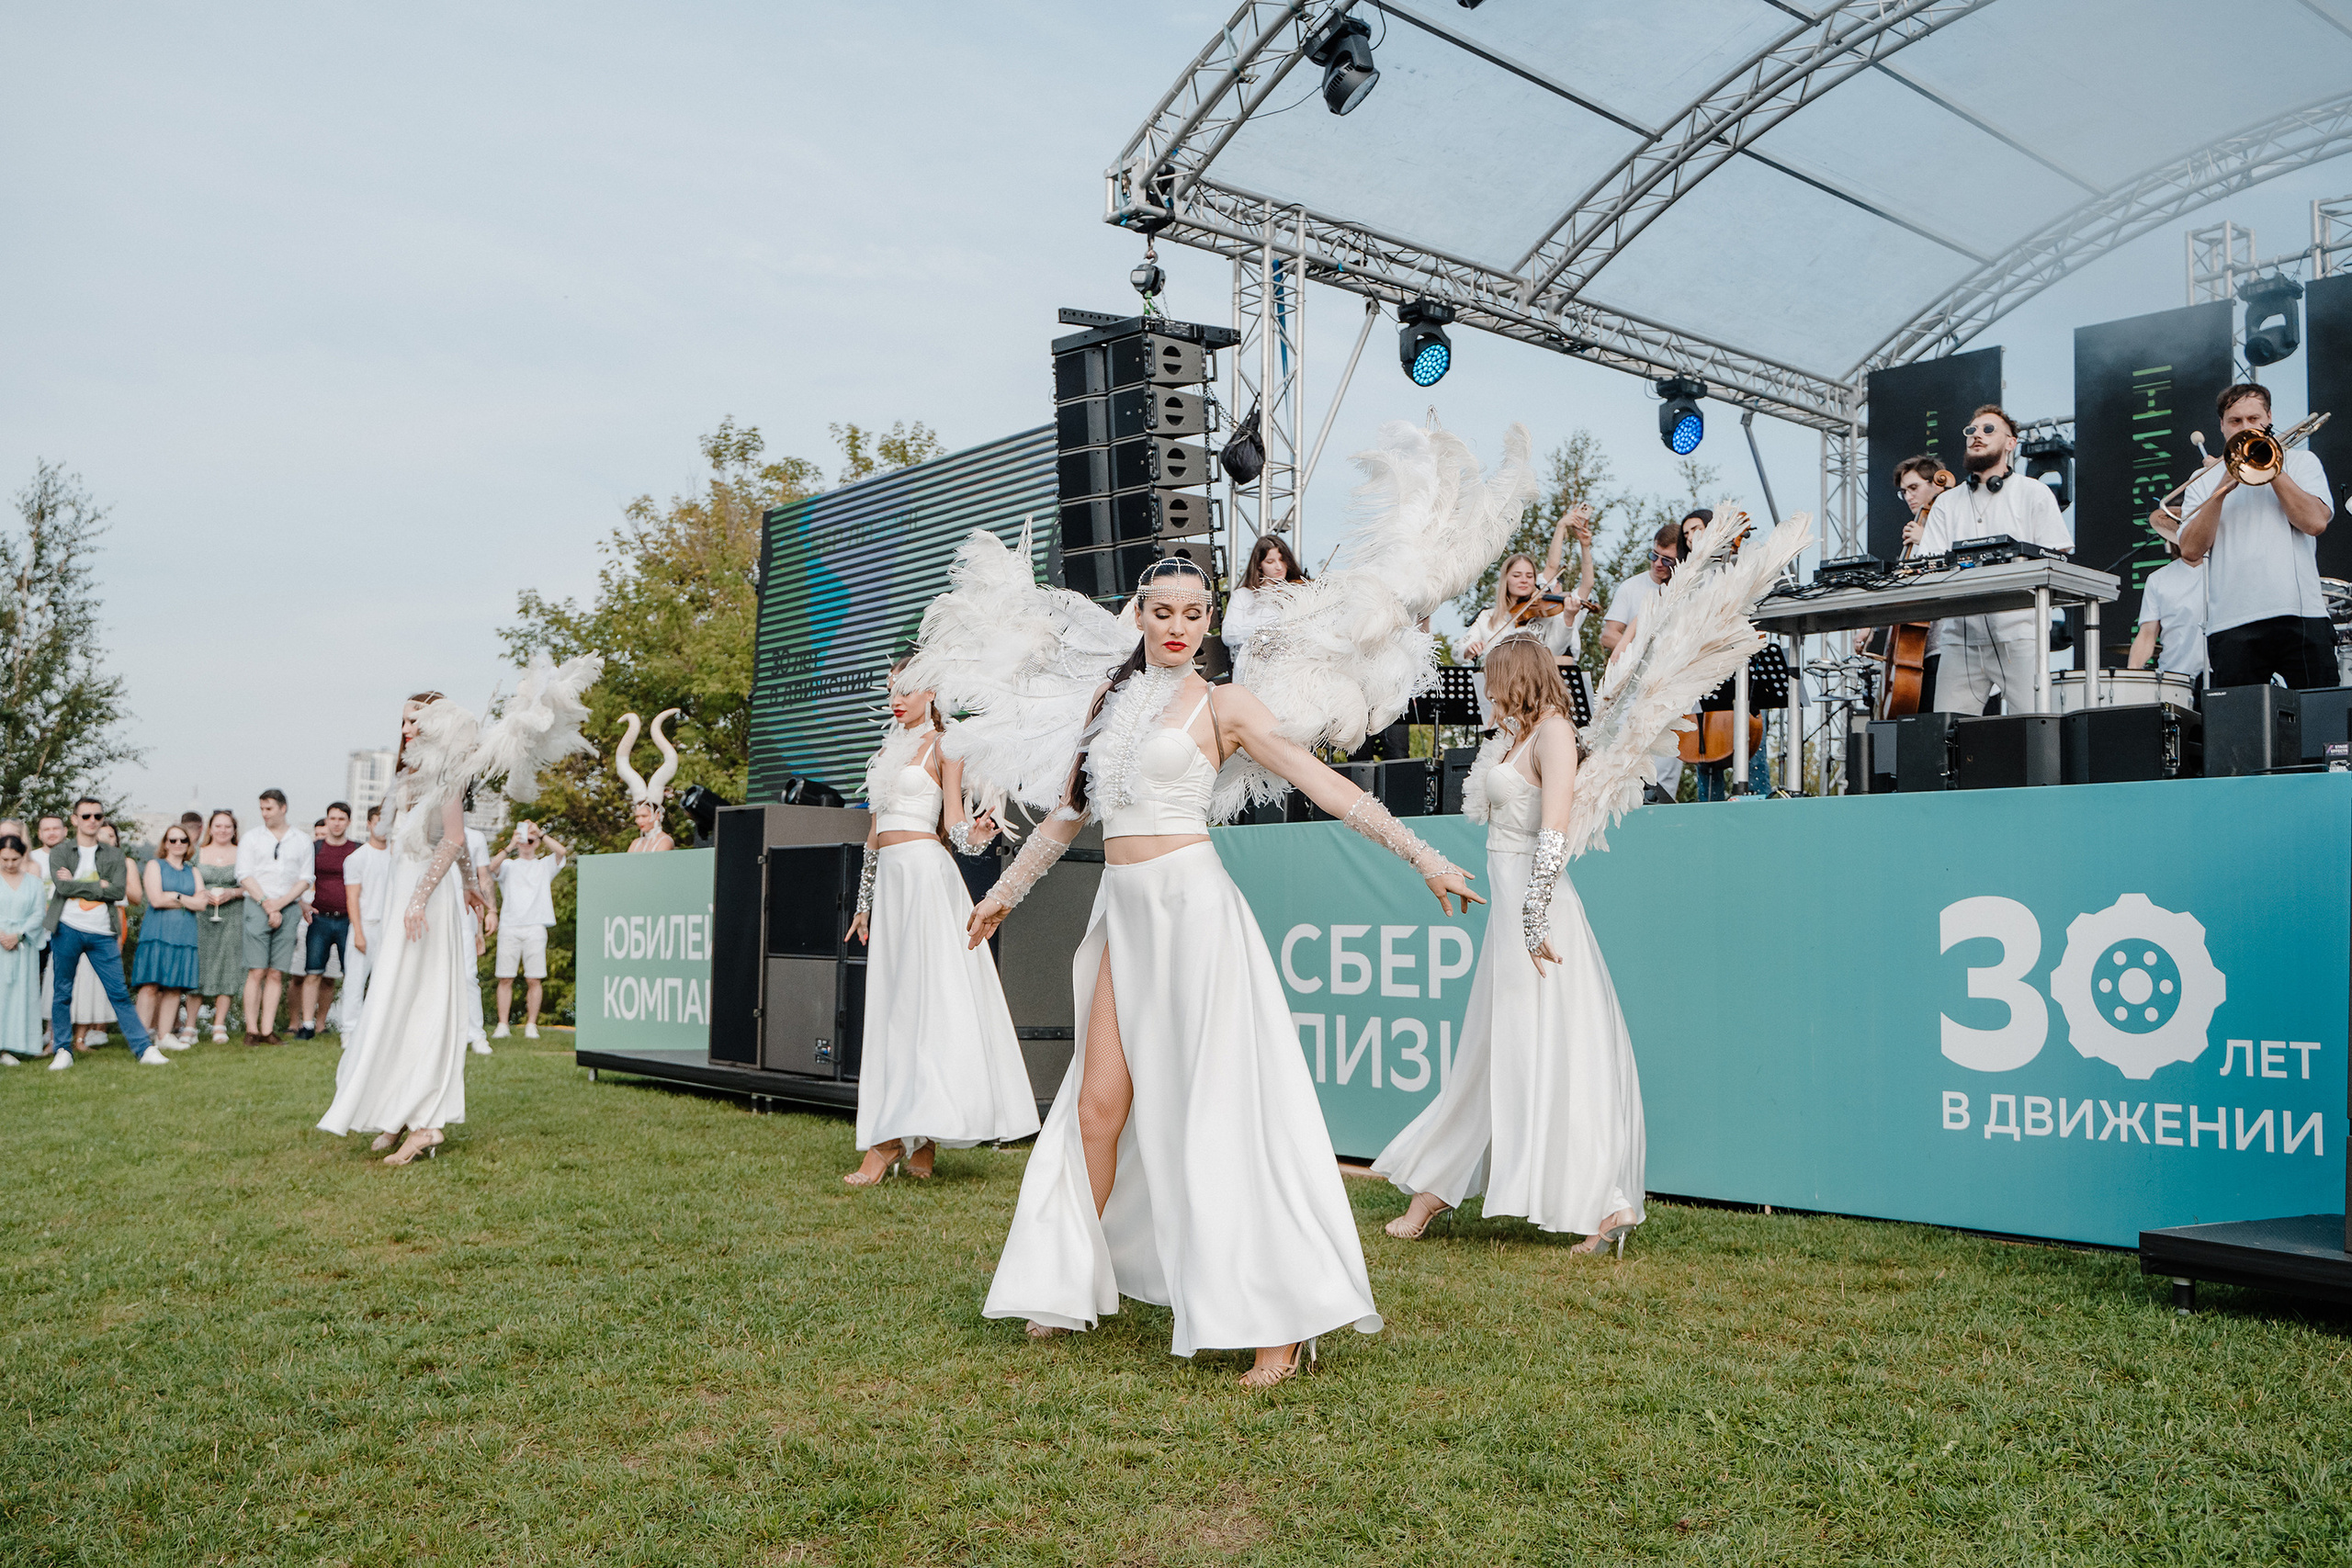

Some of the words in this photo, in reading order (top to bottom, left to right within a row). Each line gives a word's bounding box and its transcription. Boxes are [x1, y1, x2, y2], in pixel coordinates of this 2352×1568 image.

[1281, 923, 1474, 999] СБЕР
[604, 976, 711, 1024] КОМПА
[2220, 1039, 2322, 1080] ЛЕТ
[1942, 1090, 1971, 1131] В
[1984, 1093, 2324, 1157] ДВИЖЕНИИ
